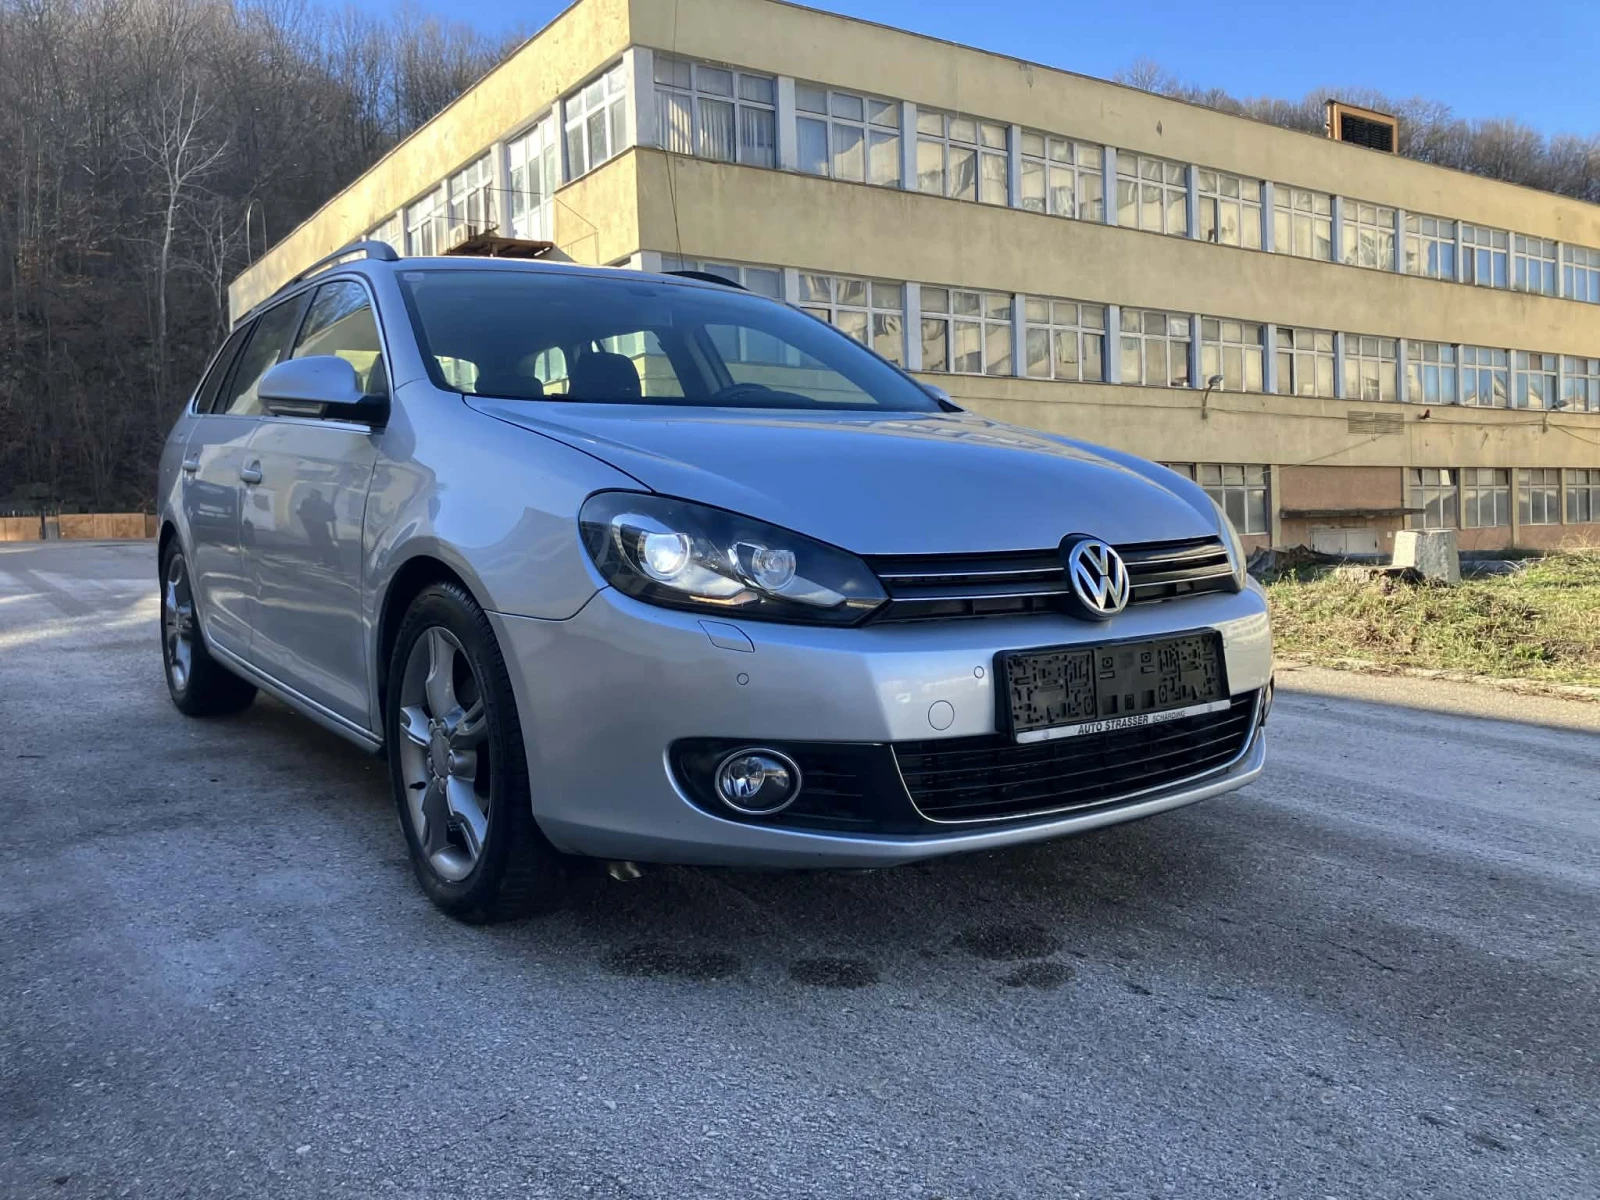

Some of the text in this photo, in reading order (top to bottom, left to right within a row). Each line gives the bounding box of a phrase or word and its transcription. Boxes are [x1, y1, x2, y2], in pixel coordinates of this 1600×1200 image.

[1069, 540, 1129, 612] VW
[1078, 722, 1102, 735] AUTO
[1105, 715, 1149, 730] STRASSER
